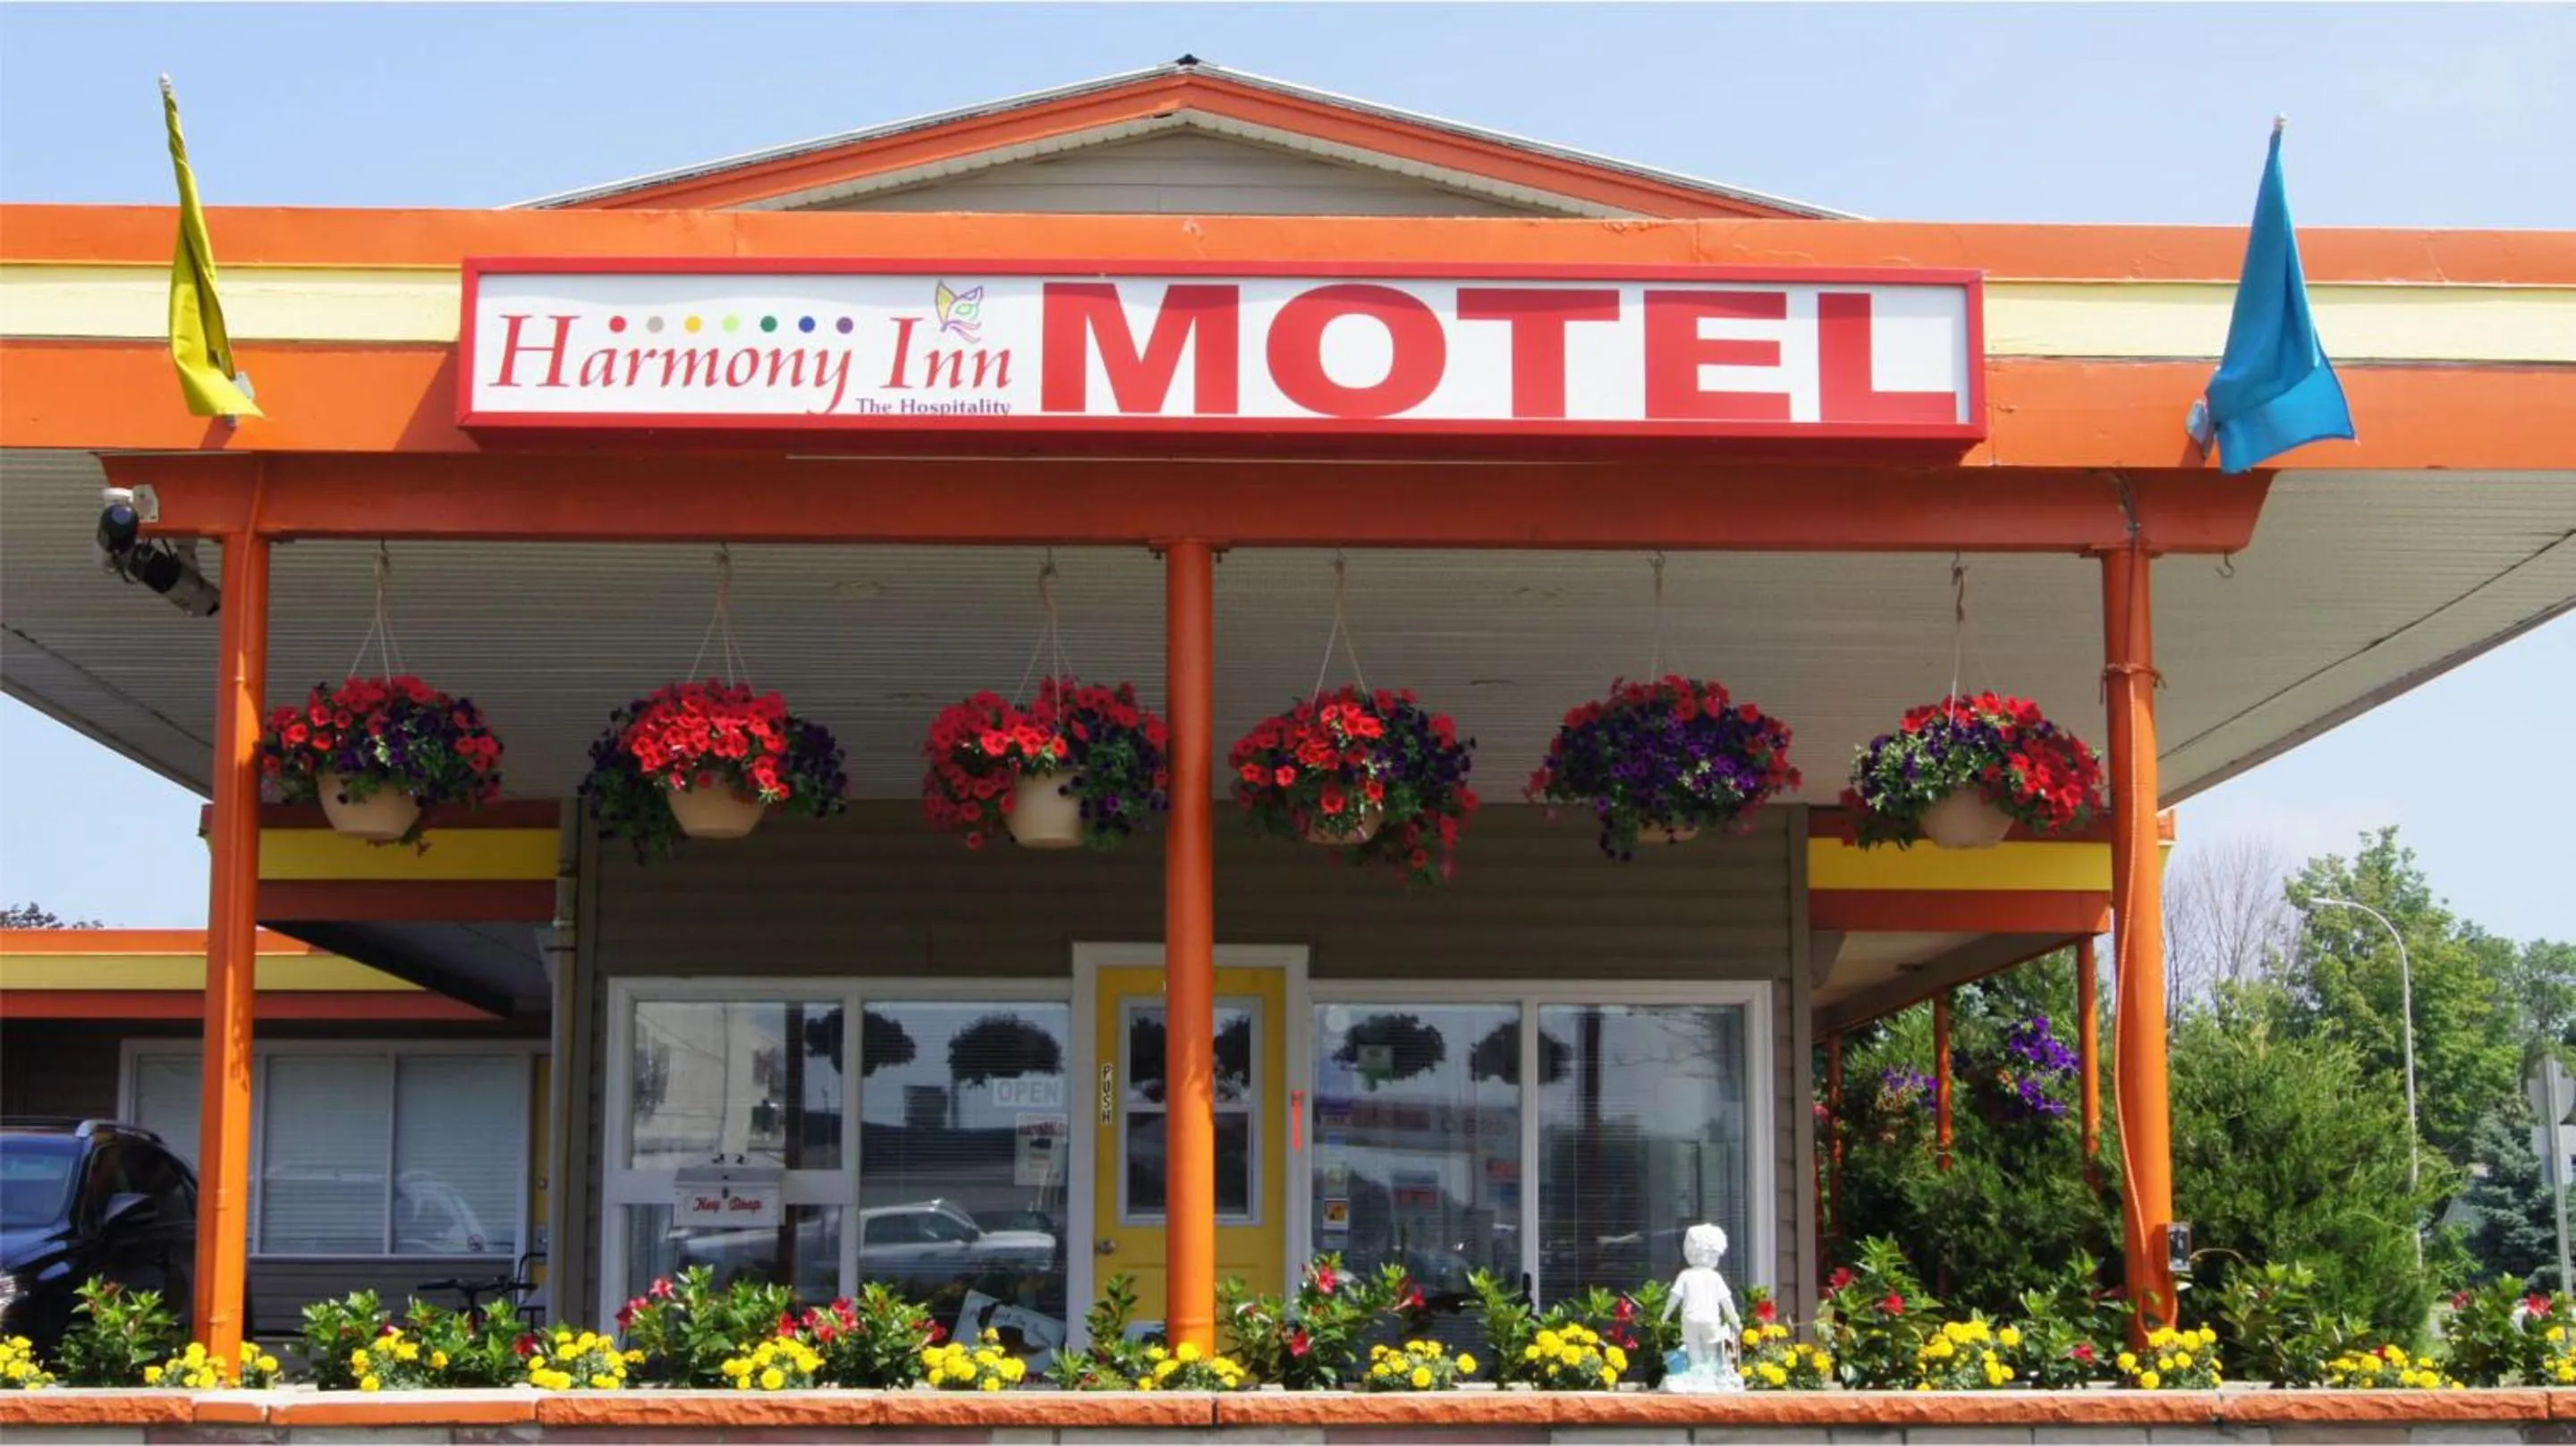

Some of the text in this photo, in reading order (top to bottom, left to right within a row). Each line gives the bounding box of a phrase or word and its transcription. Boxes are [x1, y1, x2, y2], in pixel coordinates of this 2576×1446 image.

[487, 314, 1012, 415] Harmony Inn
[1040, 282, 1958, 424] MOTEL
[855, 398, 1012, 416] The Hospitality
[996, 1080, 1059, 1104] OPEN
[1101, 1064, 1113, 1125] PUSH
